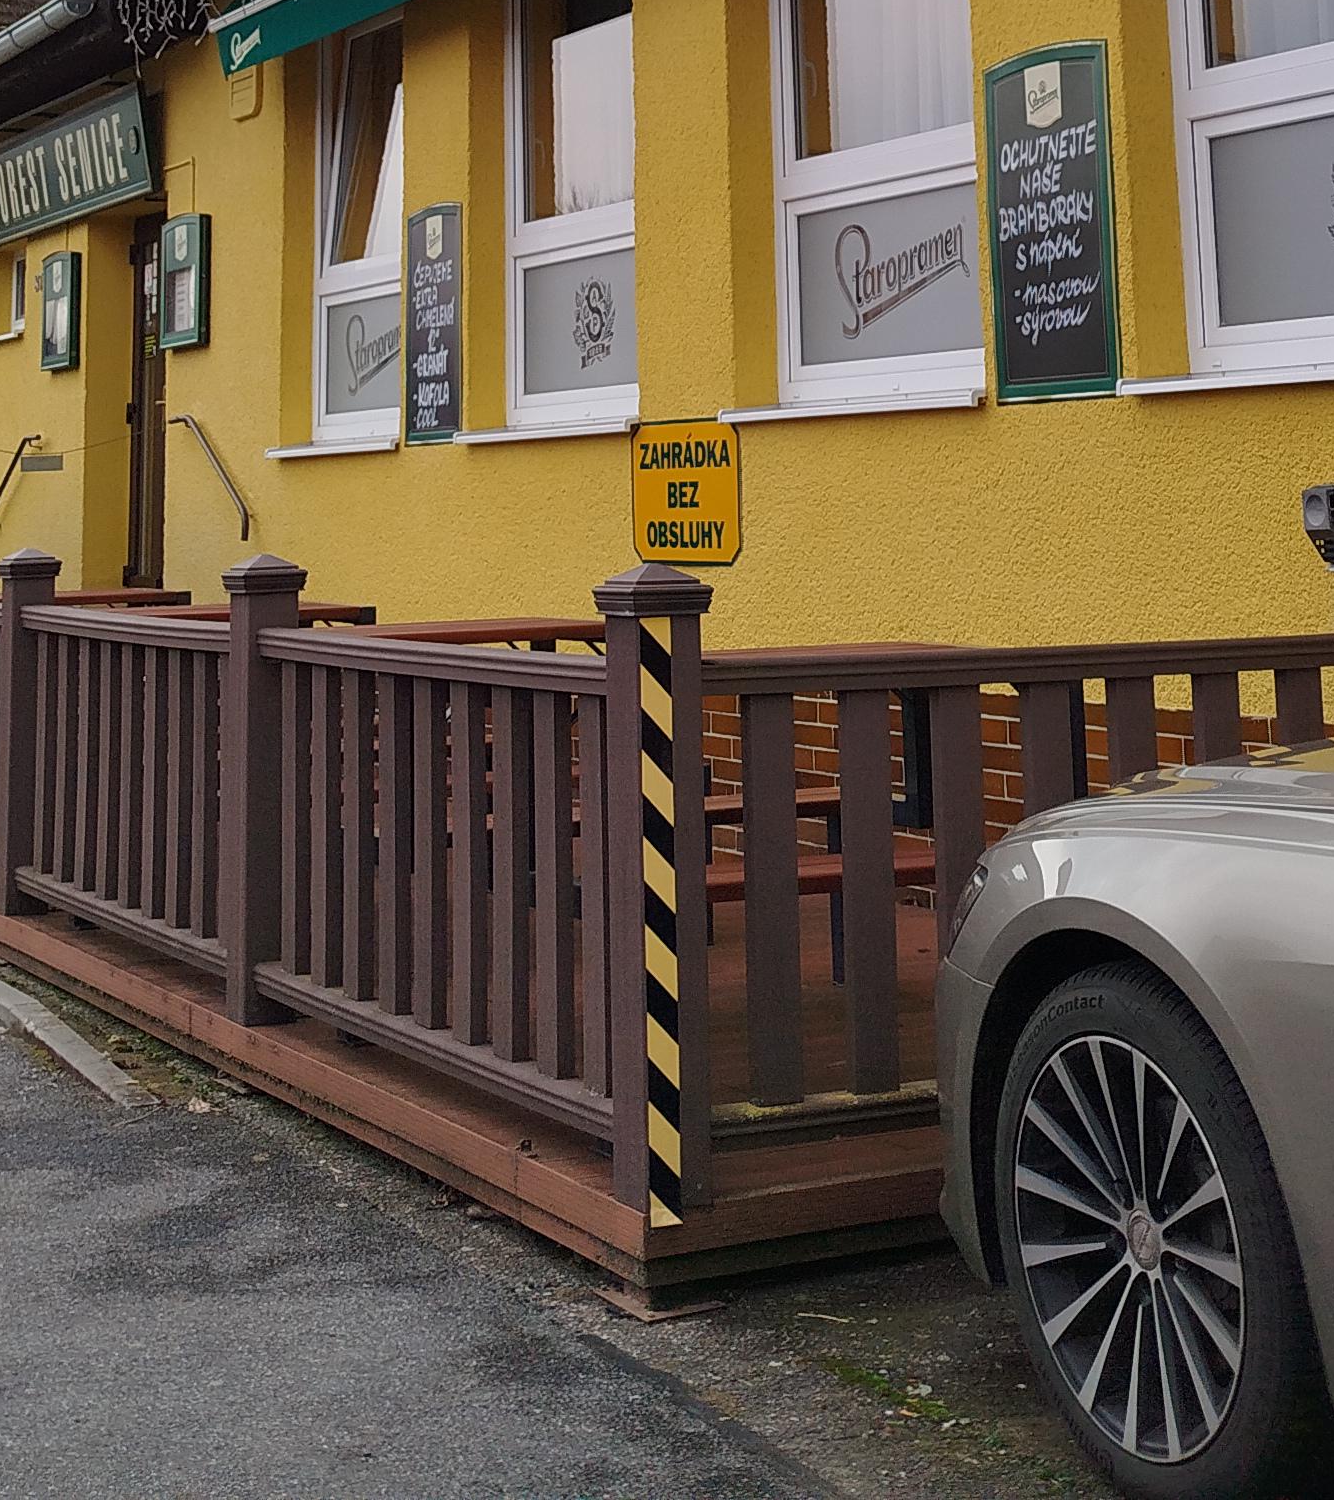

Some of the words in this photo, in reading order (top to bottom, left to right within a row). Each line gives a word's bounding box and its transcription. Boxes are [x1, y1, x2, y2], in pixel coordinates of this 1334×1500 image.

[54, 113, 130, 201] SENICE
[1000, 119, 1097, 172] OCHUTNEJTE
[1019, 161, 1063, 199] NAŠE
[999, 189, 1094, 242] BRAMBORÁKY
[835, 223, 970, 339] Staropramen
[347, 314, 401, 396] Staropram
[639, 433, 731, 470] ZAHRÁDKA
[667, 481, 700, 509] BEZ
[646, 521, 725, 549] OBSLUHY
